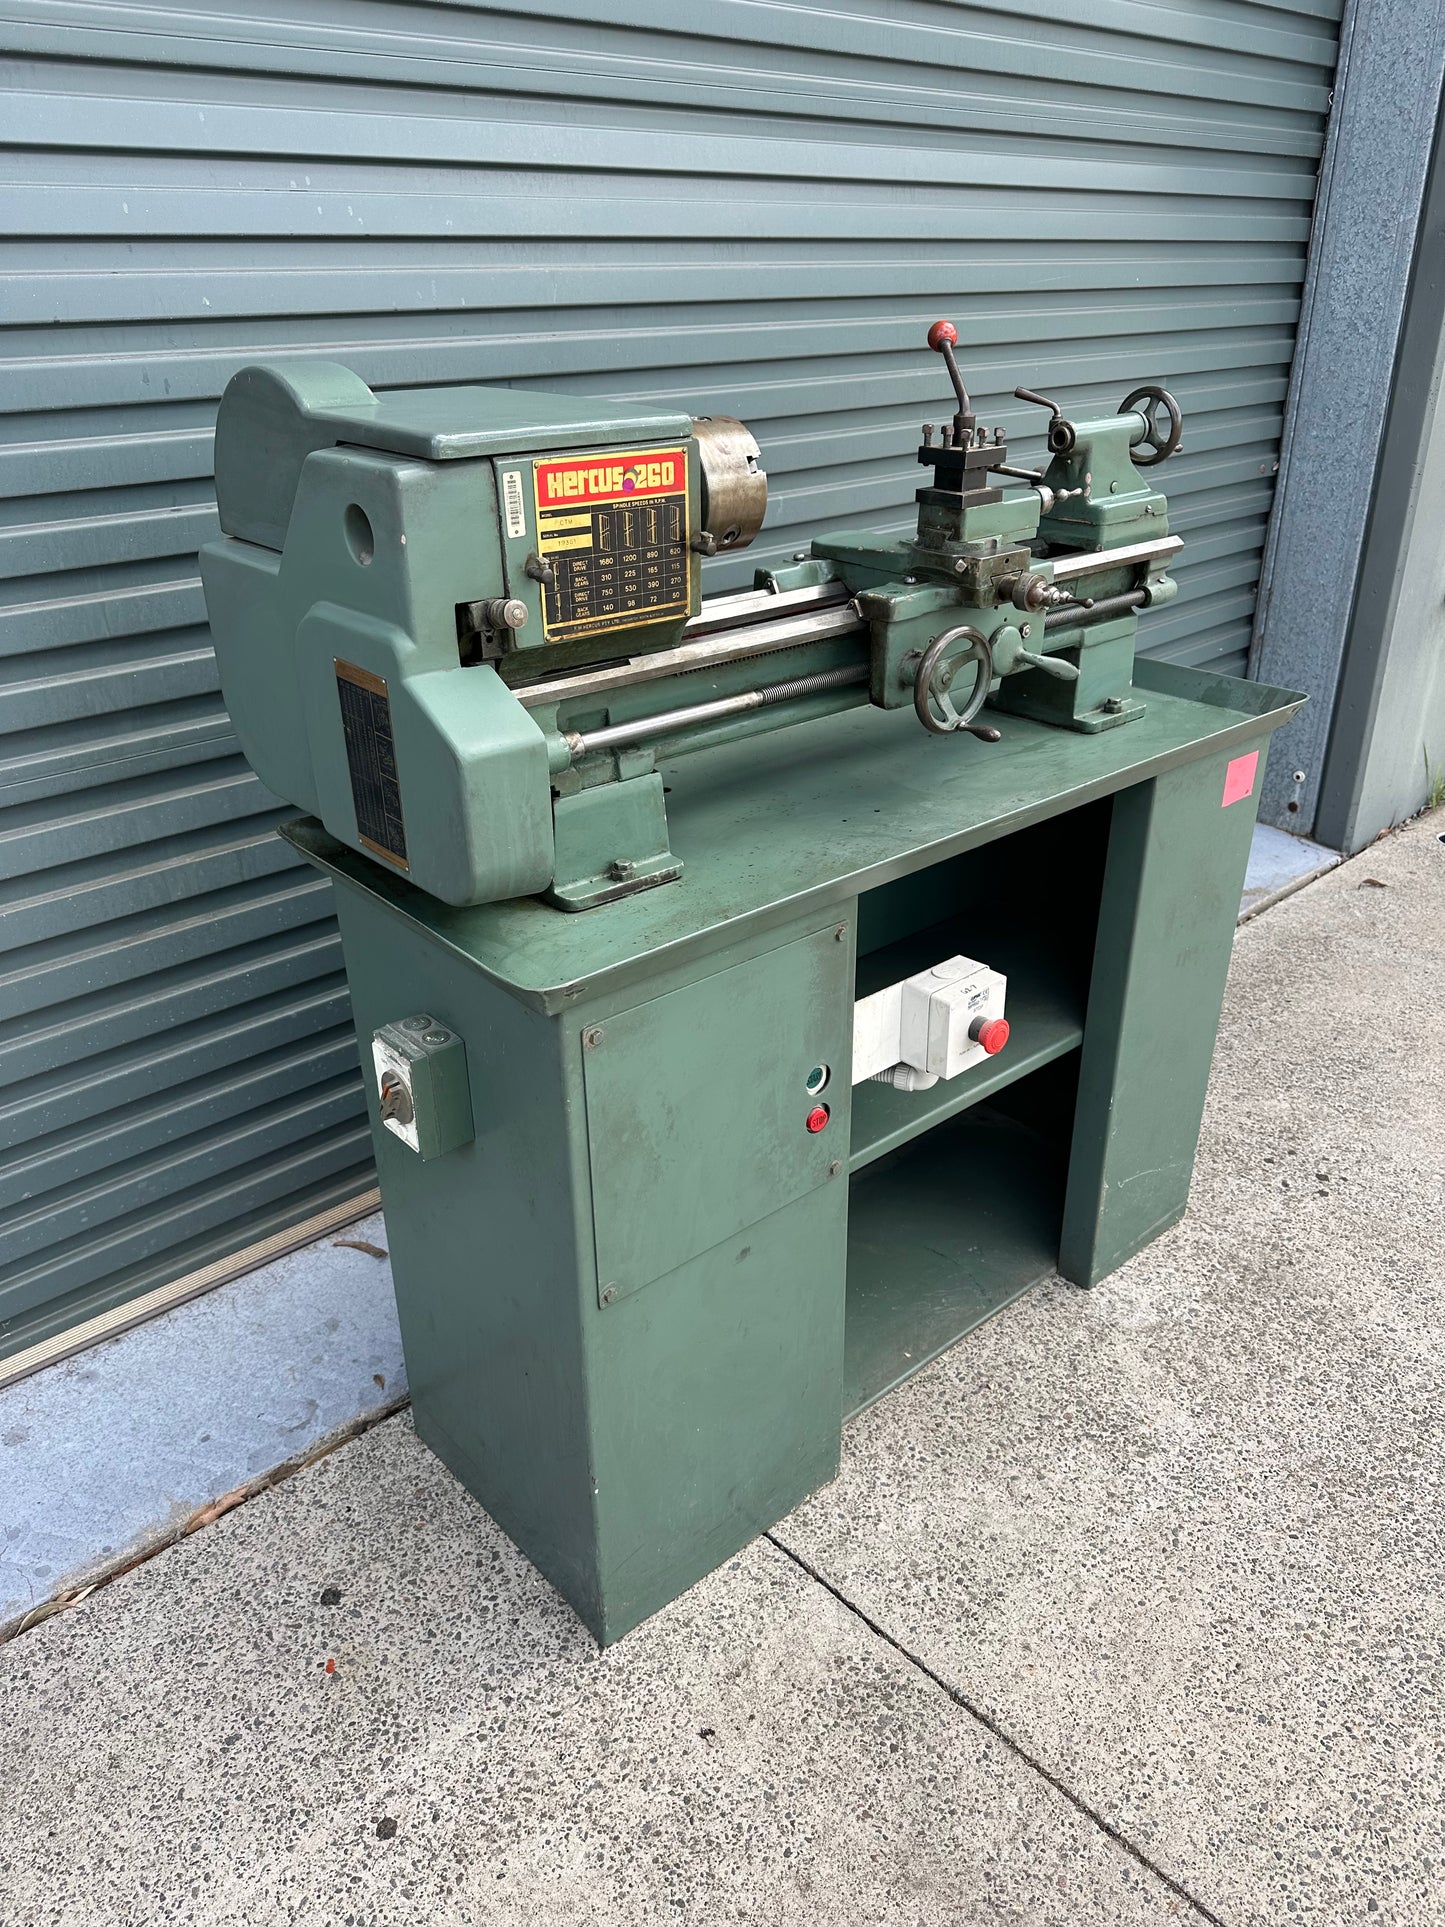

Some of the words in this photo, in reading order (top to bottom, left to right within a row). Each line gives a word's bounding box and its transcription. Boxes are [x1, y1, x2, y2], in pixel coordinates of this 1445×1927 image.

[548, 466, 624, 498] Hercus
[634, 462, 674, 488] 260
[600, 558, 614, 566] 1680
[812, 1114, 826, 1128] STOP
